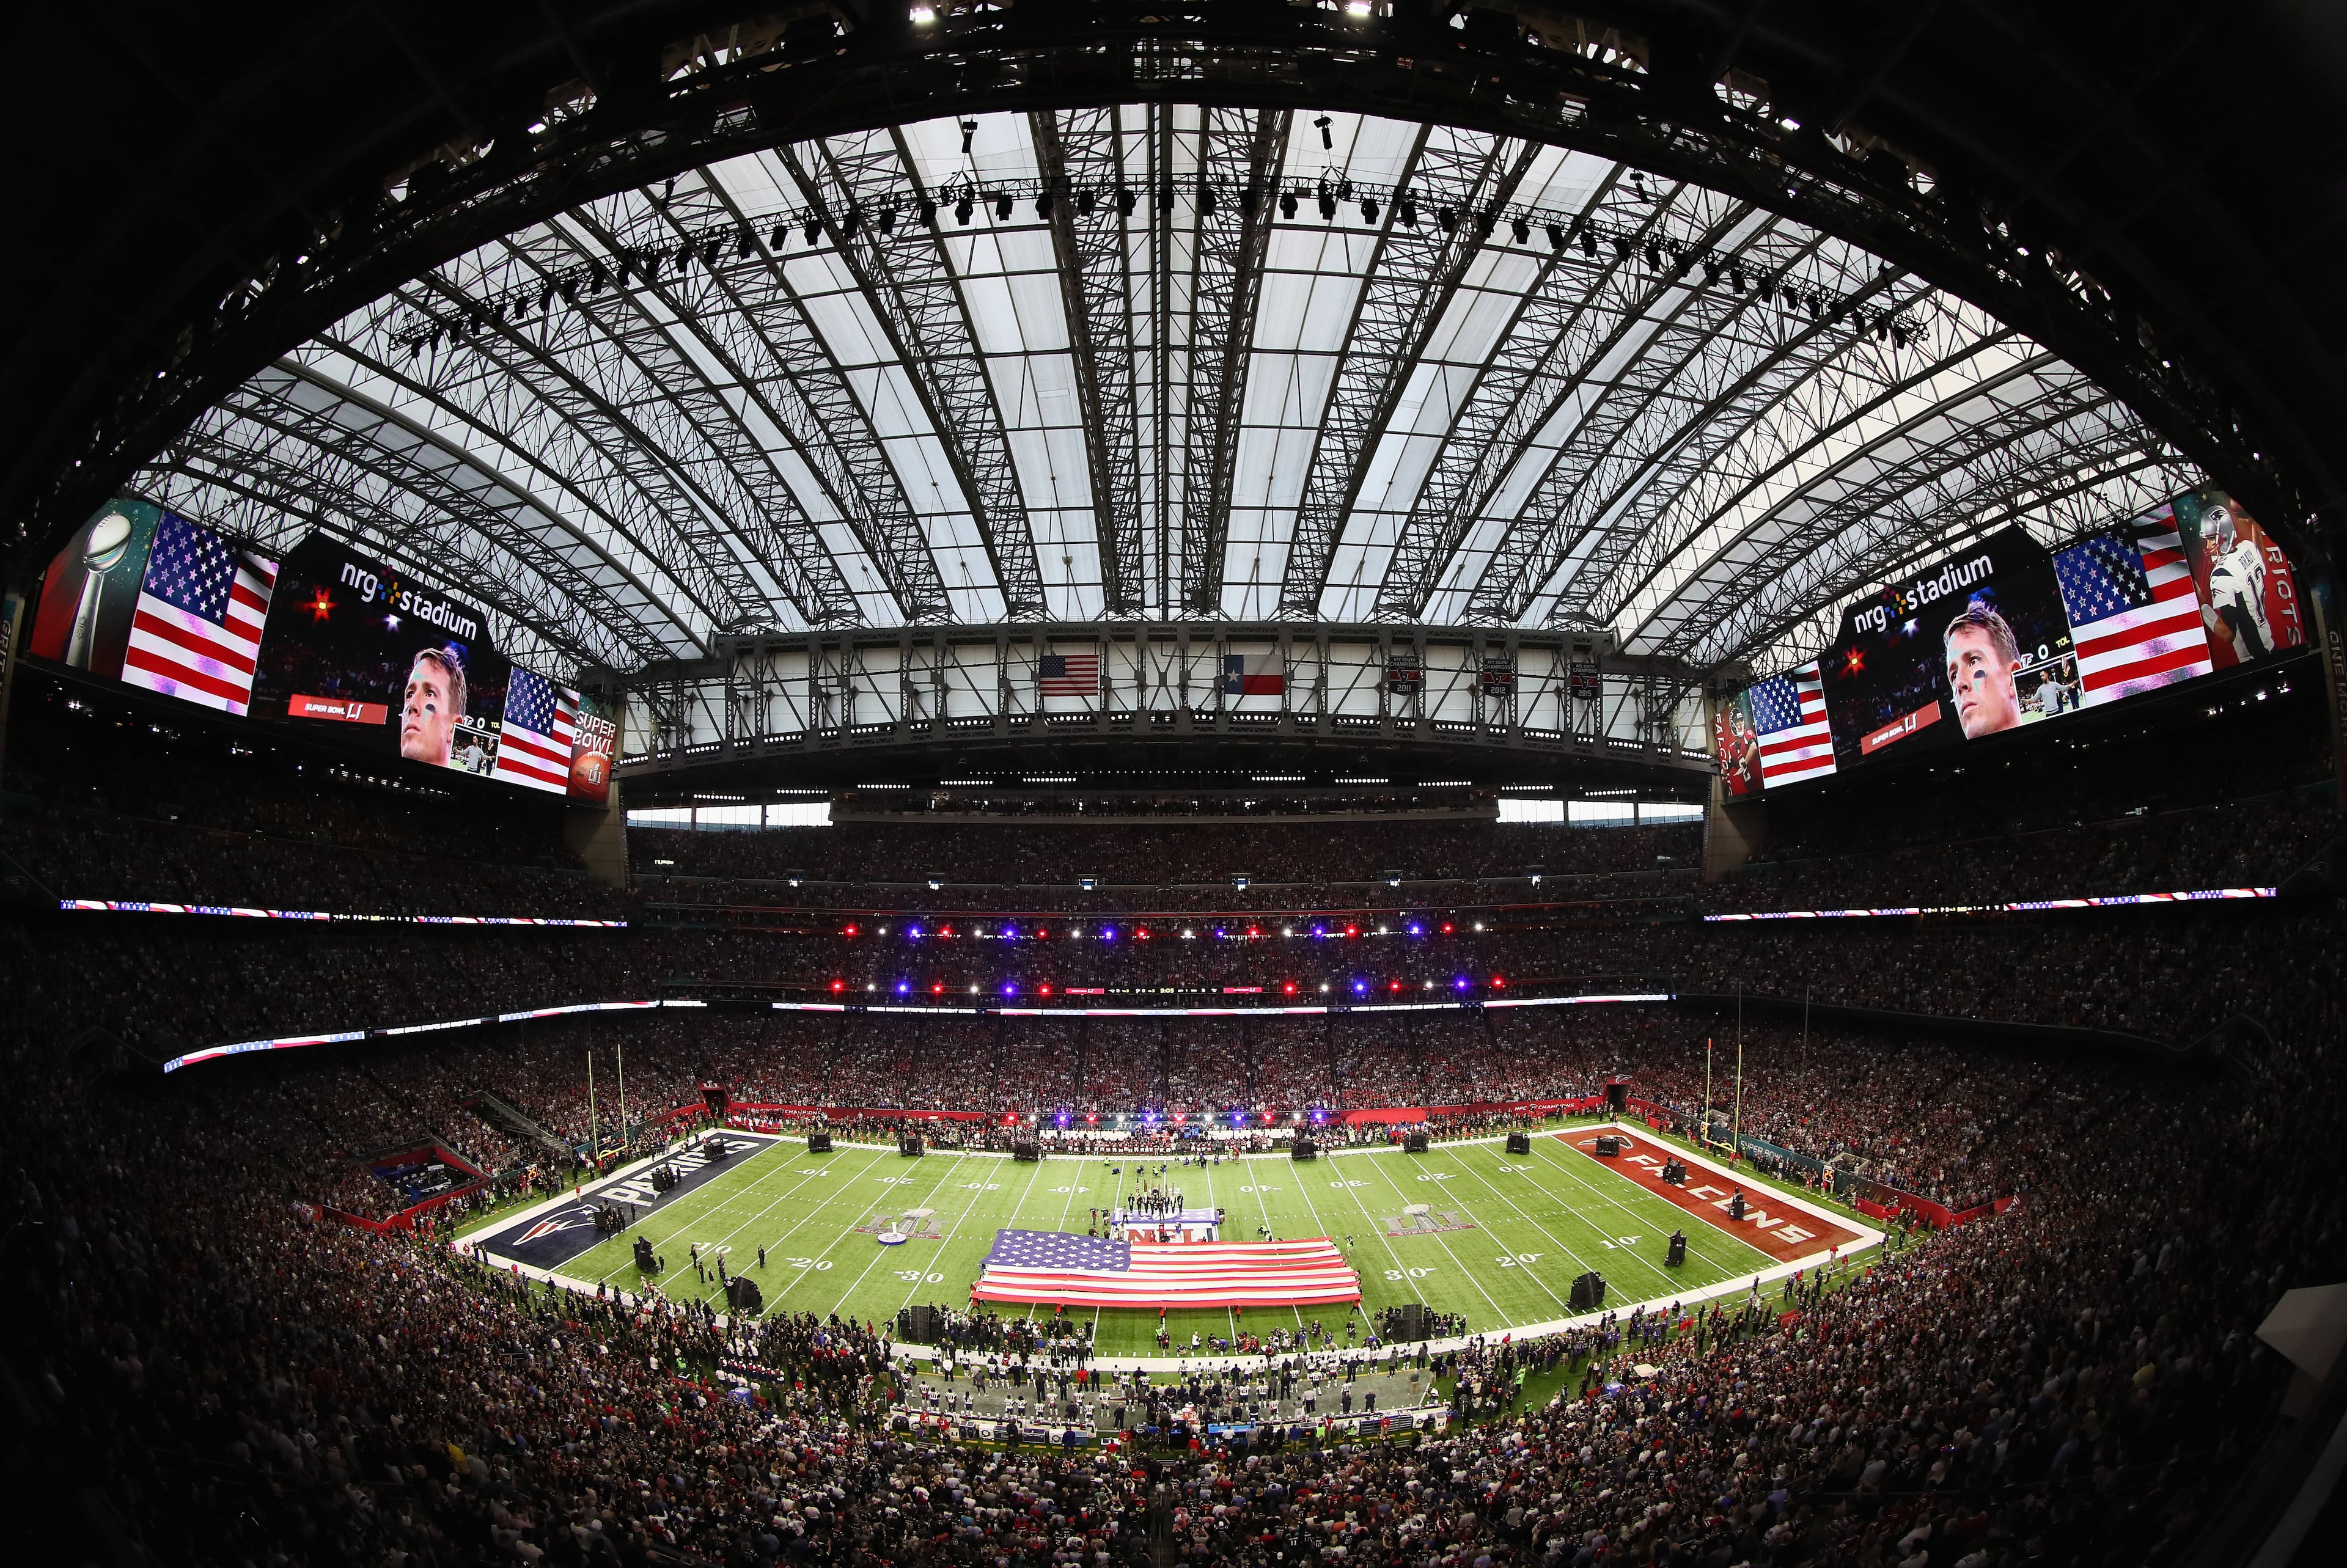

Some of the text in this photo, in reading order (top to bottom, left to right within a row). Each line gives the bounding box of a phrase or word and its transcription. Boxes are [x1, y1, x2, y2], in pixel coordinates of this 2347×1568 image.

[2238, 549, 2256, 571] BRADY
[340, 562, 477, 640] nrg stadium
[1854, 555, 1994, 634] nrg stadium
[2055, 636, 2070, 648] TOL
[2038, 644, 2049, 660] 0
[304, 703, 364, 720] SUPER BOWL LI
[477, 717, 485, 729] 0
[575, 710, 617, 739] SUPER
[1871, 713, 1917, 746] SUPER BOWL LI
[572, 727, 614, 755] BOWL
[527, 1168, 537, 1179] 25
[1417, 1173, 1449, 1182] 20
[1824, 1170, 1834, 1180] 25
[883, 1176, 916, 1185] 20
[968, 1182, 1001, 1191] 30
[1330, 1180, 1362, 1189] 30
[1240, 1185, 1274, 1193] 40
[1600, 1236, 1636, 1250] 10
[791, 1258, 833, 1270] 20
[1495, 1253, 1537, 1267] 20
[901, 1270, 944, 1283] 30
[1384, 1267, 1427, 1281] 30
